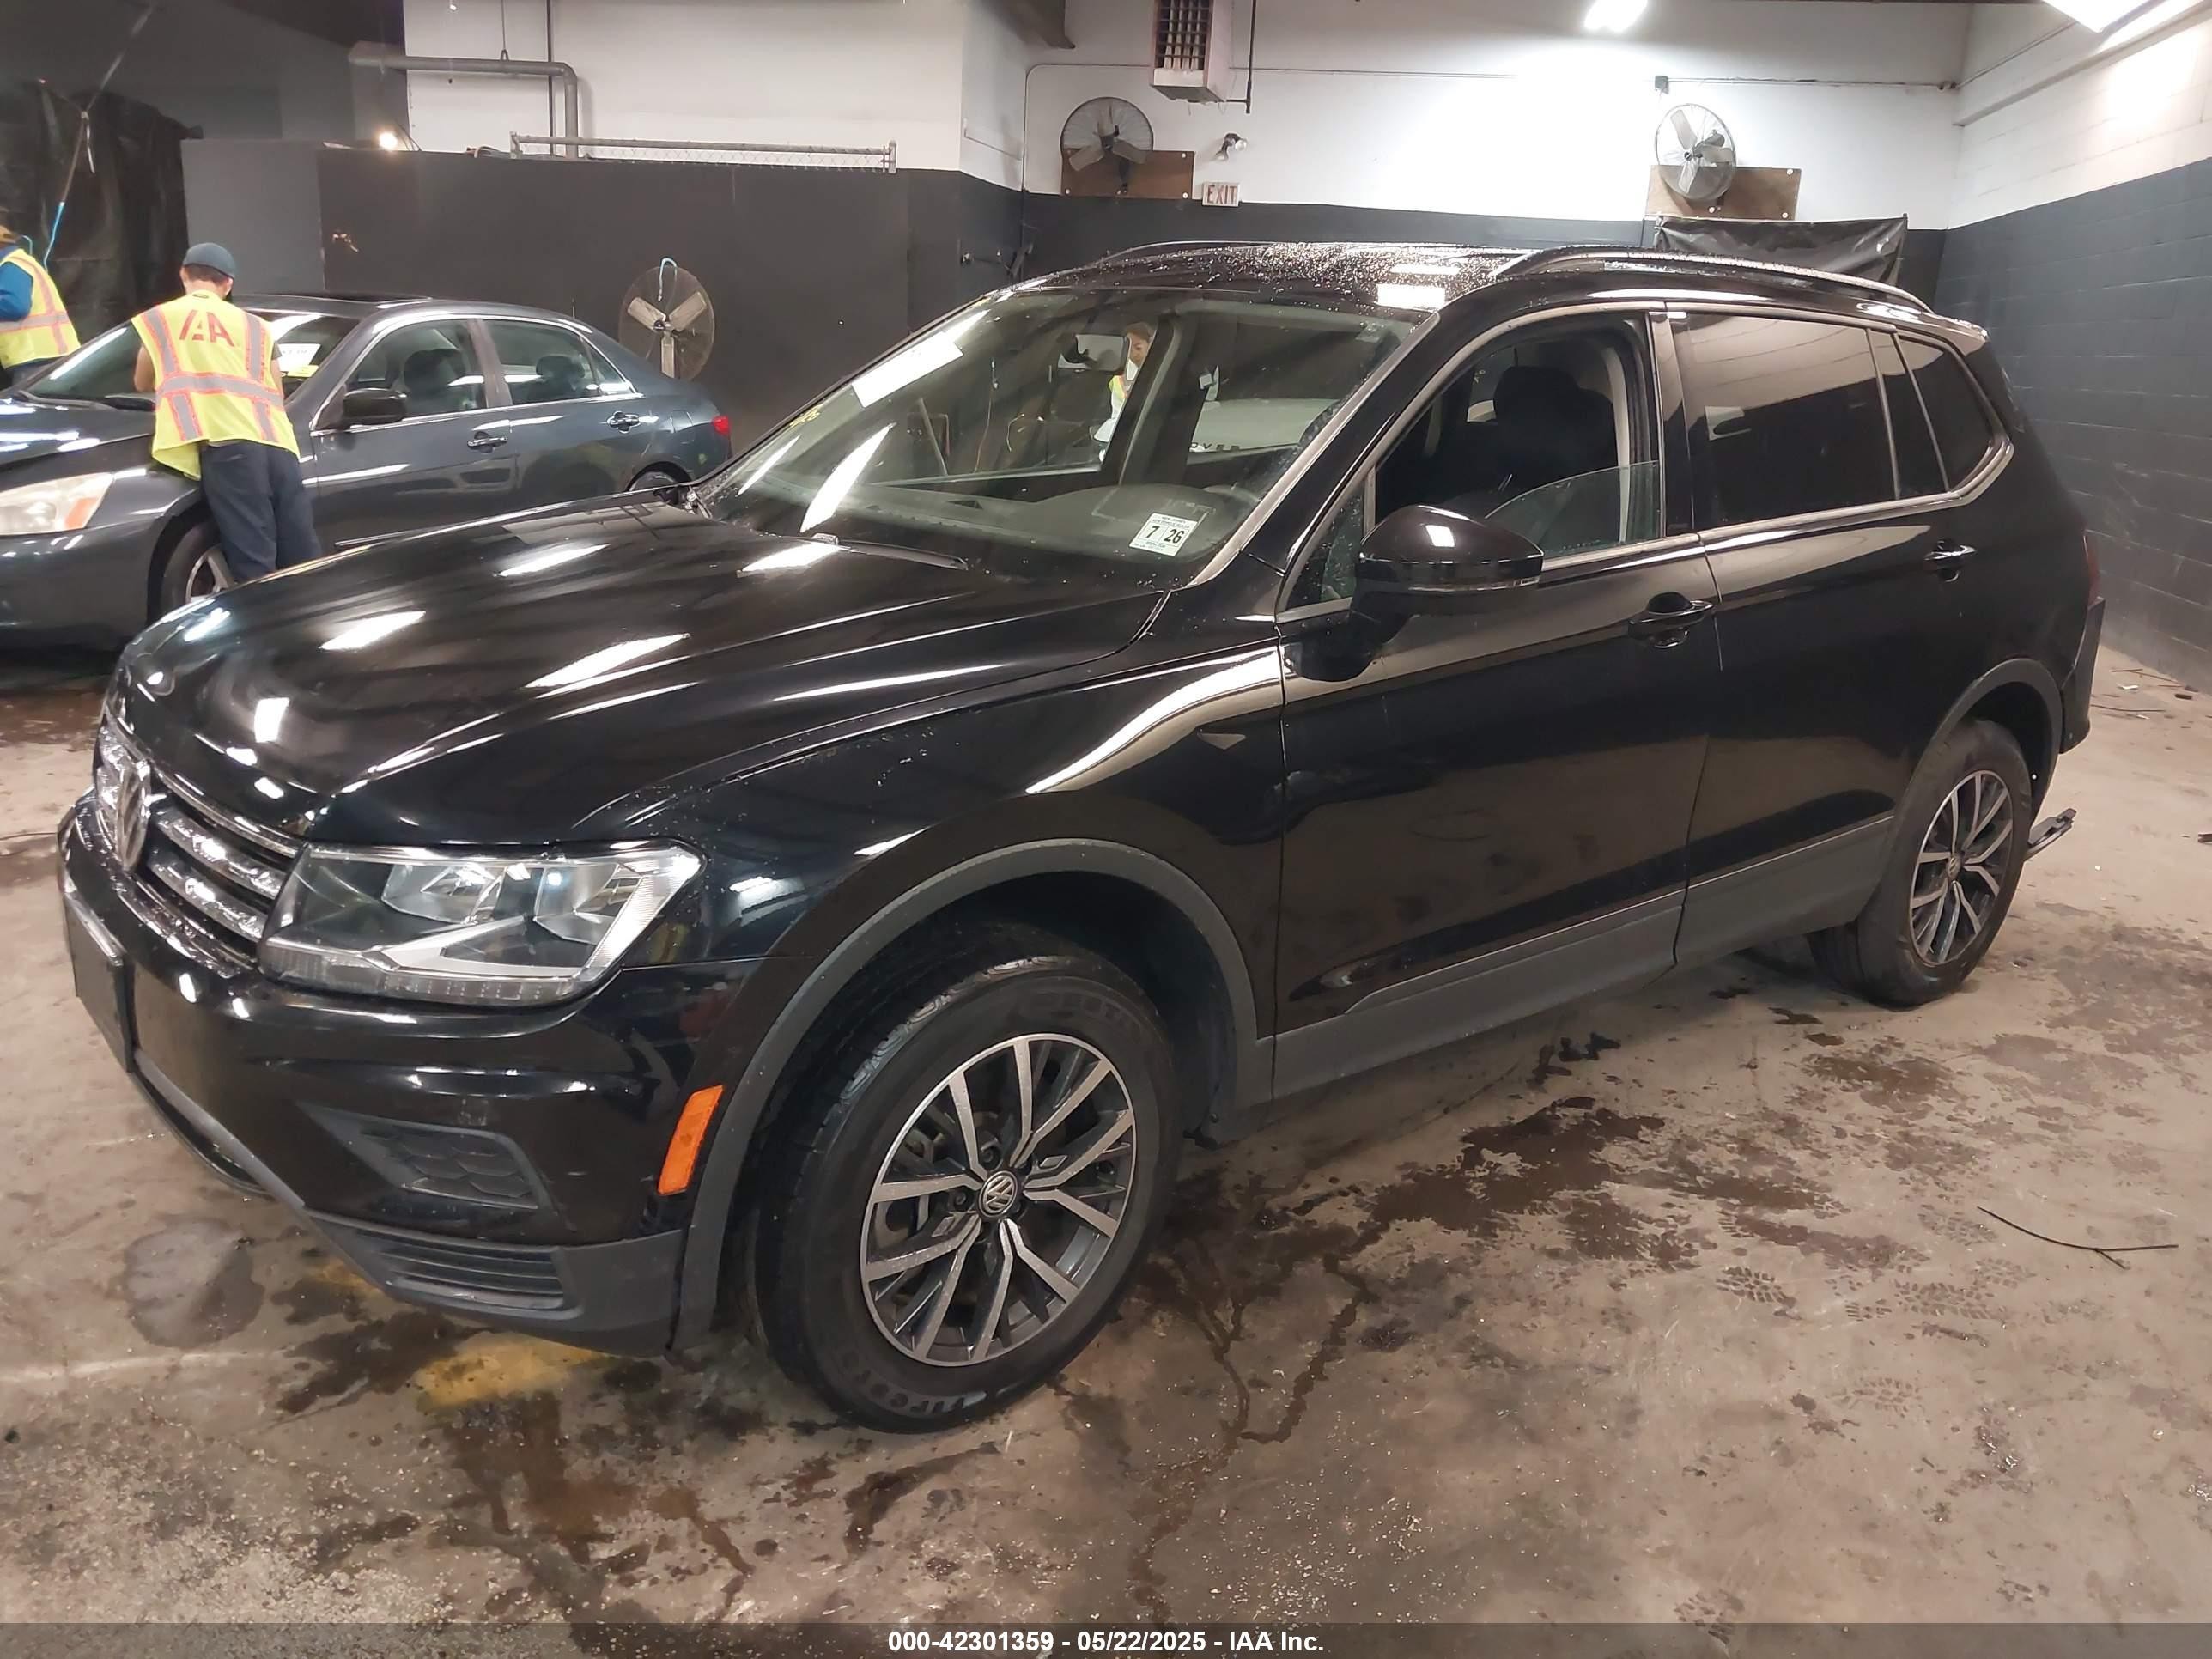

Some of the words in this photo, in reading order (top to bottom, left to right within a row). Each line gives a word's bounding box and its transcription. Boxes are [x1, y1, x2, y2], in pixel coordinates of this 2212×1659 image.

[1207, 184, 1237, 204] EXIT
[1146, 526, 1160, 539] 7
[1164, 528, 1185, 544] 26
